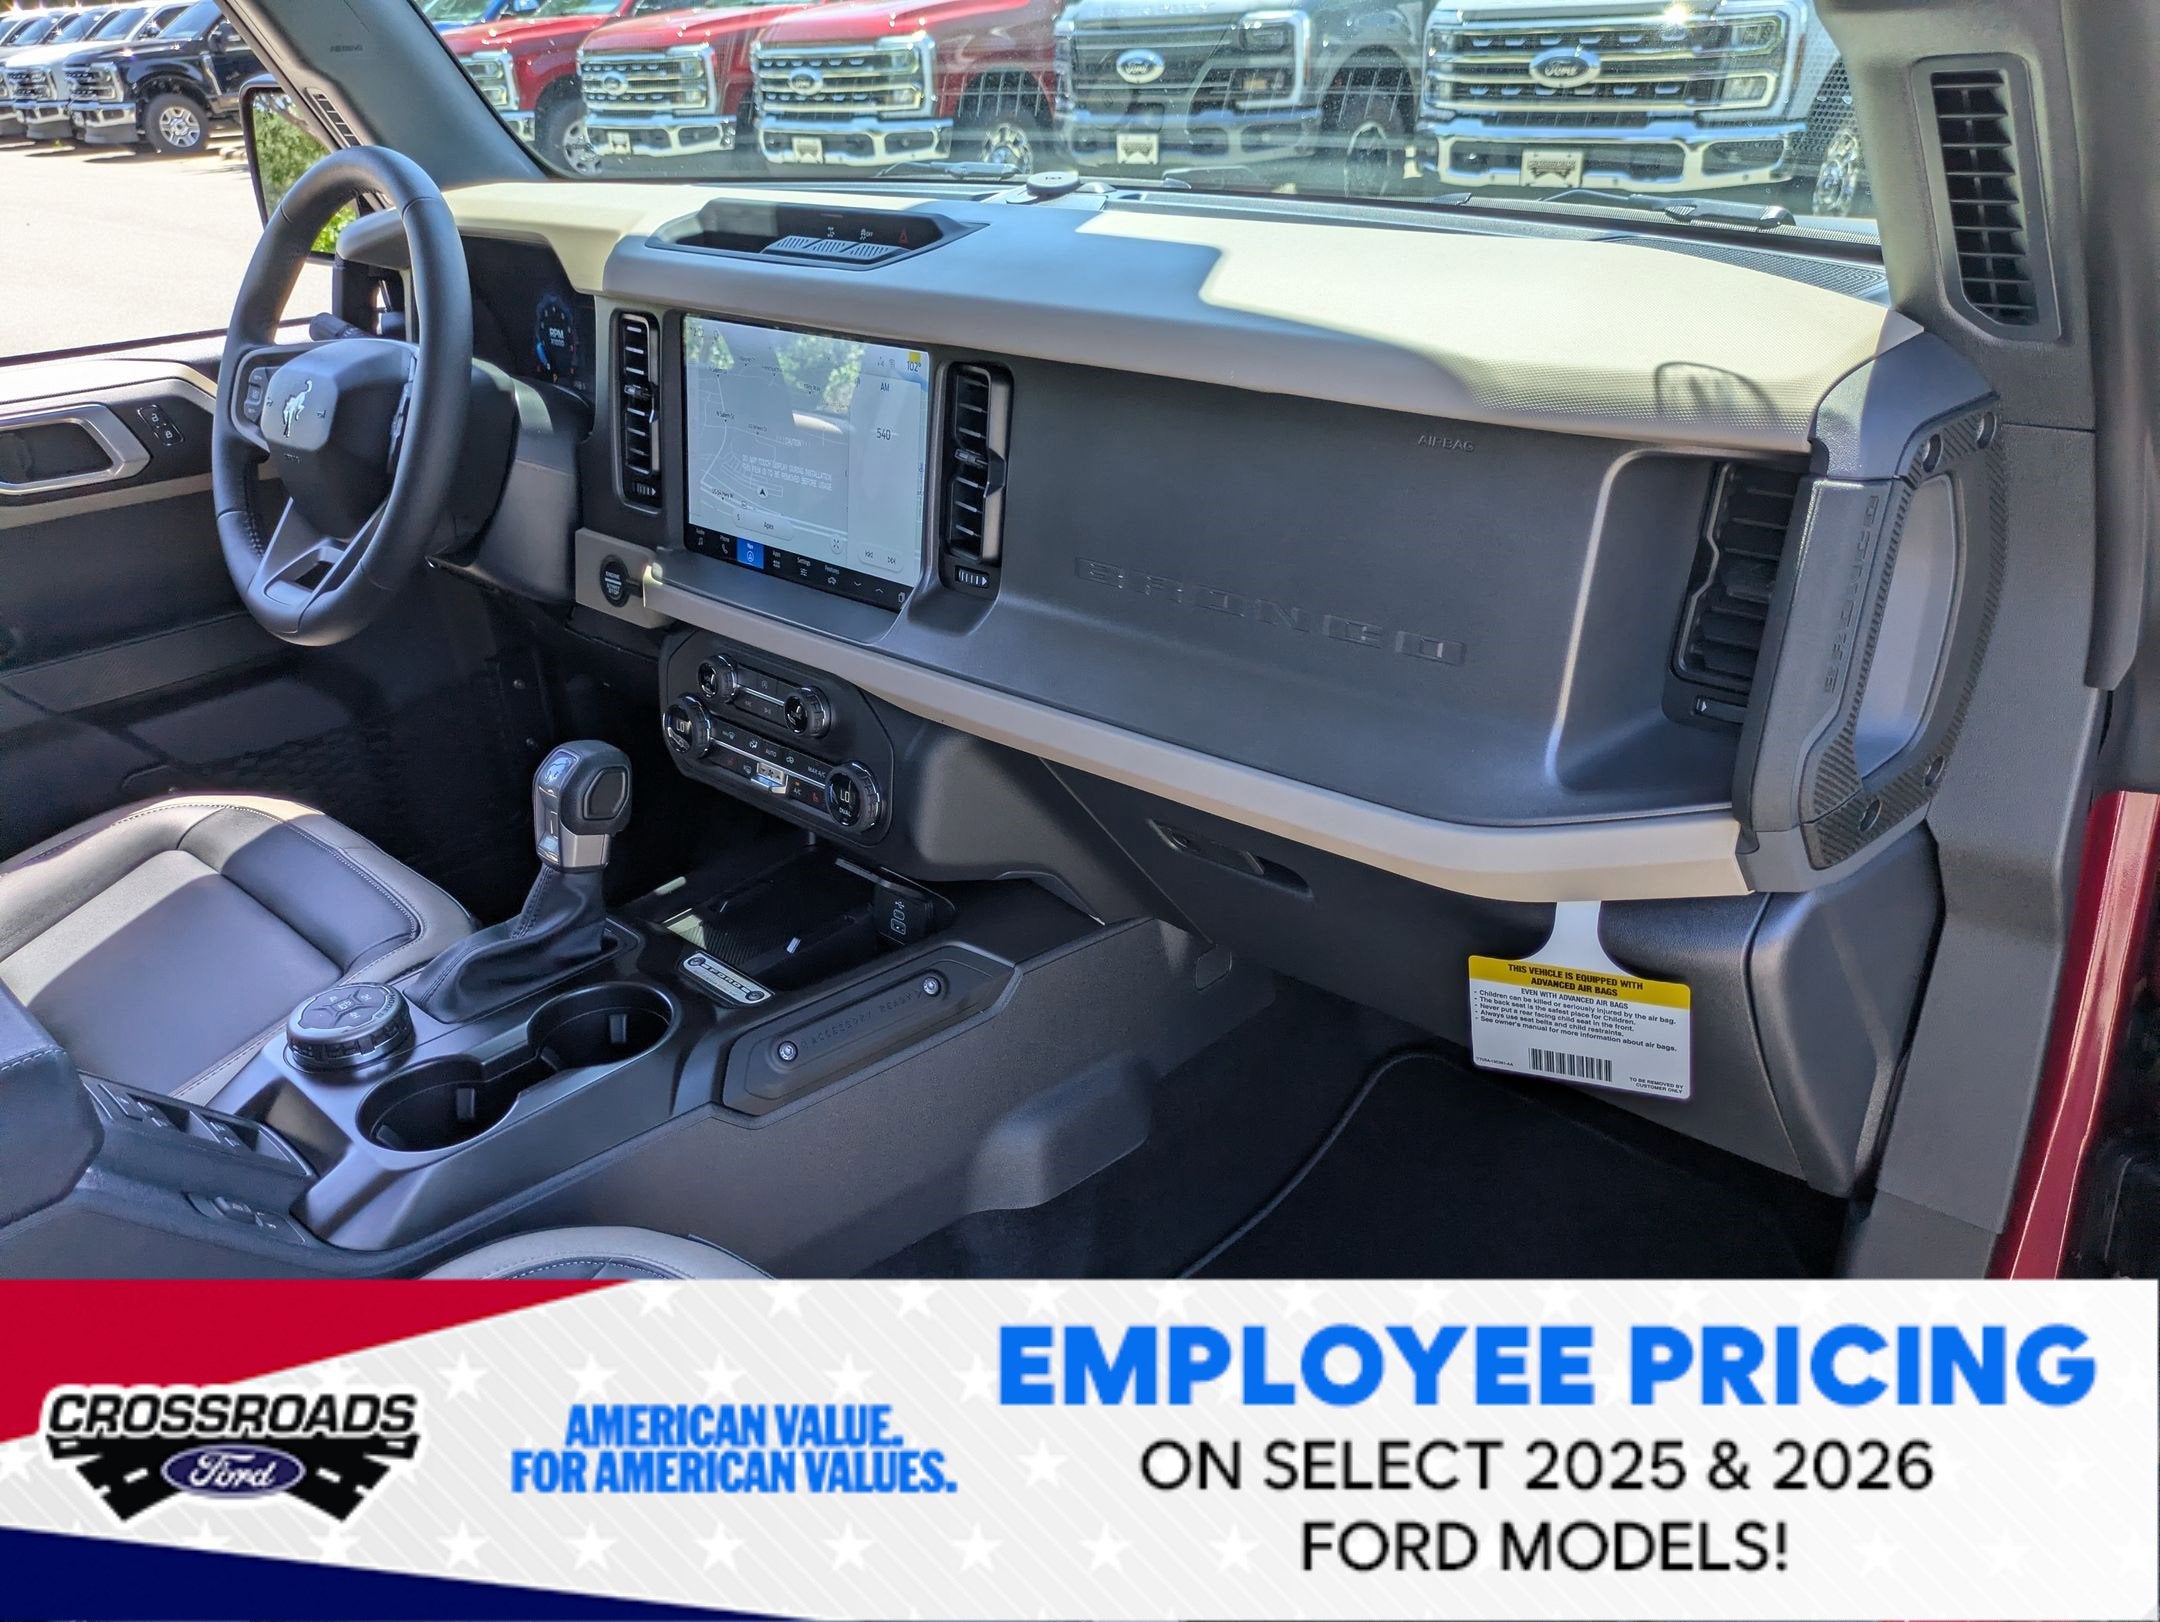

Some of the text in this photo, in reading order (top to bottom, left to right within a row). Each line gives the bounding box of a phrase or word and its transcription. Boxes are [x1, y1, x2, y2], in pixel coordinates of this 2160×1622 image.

[1545, 60, 1578, 77] Ford
[549, 327, 565, 339] RPM
[880, 382, 890, 392] AM
[876, 427, 891, 440] 540
[1418, 435, 1475, 452] AIRBAG
[1074, 556, 1467, 667] BRONCO
[840, 788, 850, 803] LO
[840, 806, 852, 818] DUAL
[1508, 964, 1527, 974] THIS
[1529, 967, 1563, 978] VEHICLE
[1576, 973, 1618, 986] EQUIPPED
[1620, 980, 1643, 990] WITH
[1531, 978, 1618, 996] ADVANCED AIR BAGS
[1480, 989, 1508, 999] Children
[1534, 996, 1552, 1006] killed
[1563, 1002, 1595, 1013] seriously
[1596, 1006, 1622, 1016] injured
[1624, 1010, 1632, 1018] by
[1634, 1012, 1646, 1020] the
[1660, 1016, 1676, 1025] bag.
[1521, 988, 1538, 996] EVEN
[1559, 994, 1594, 1004] ADVANCED
[1596, 999, 1608, 1007] AIR
[1610, 1001, 1629, 1010] BAGS
[1480, 1004, 1500, 1012] Never
[1535, 1012, 1556, 1020] facing
[1558, 1015, 1575, 1023] child
[1614, 1022, 1634, 1032] front.
[1494, 998, 1510, 1006] back
[1548, 1006, 1569, 1015] safest
[1570, 1010, 1590, 1018] place
[1603, 1014, 1636, 1025] Children.
[1480, 1010, 1504, 1018] Always
[1568, 1022, 1586, 1031] child
[1588, 1026, 1624, 1036] restraints.
[1494, 1019, 1520, 1028] owner's
[1522, 1024, 1548, 1032] manual
[1580, 1032, 1621, 1043] information
[1622, 1038, 1644, 1046] about
[1656, 1044, 1677, 1052] bags.
[1635, 1082, 1666, 1092] CUSTOMER
[1646, 1079, 1674, 1088] REMOVED
